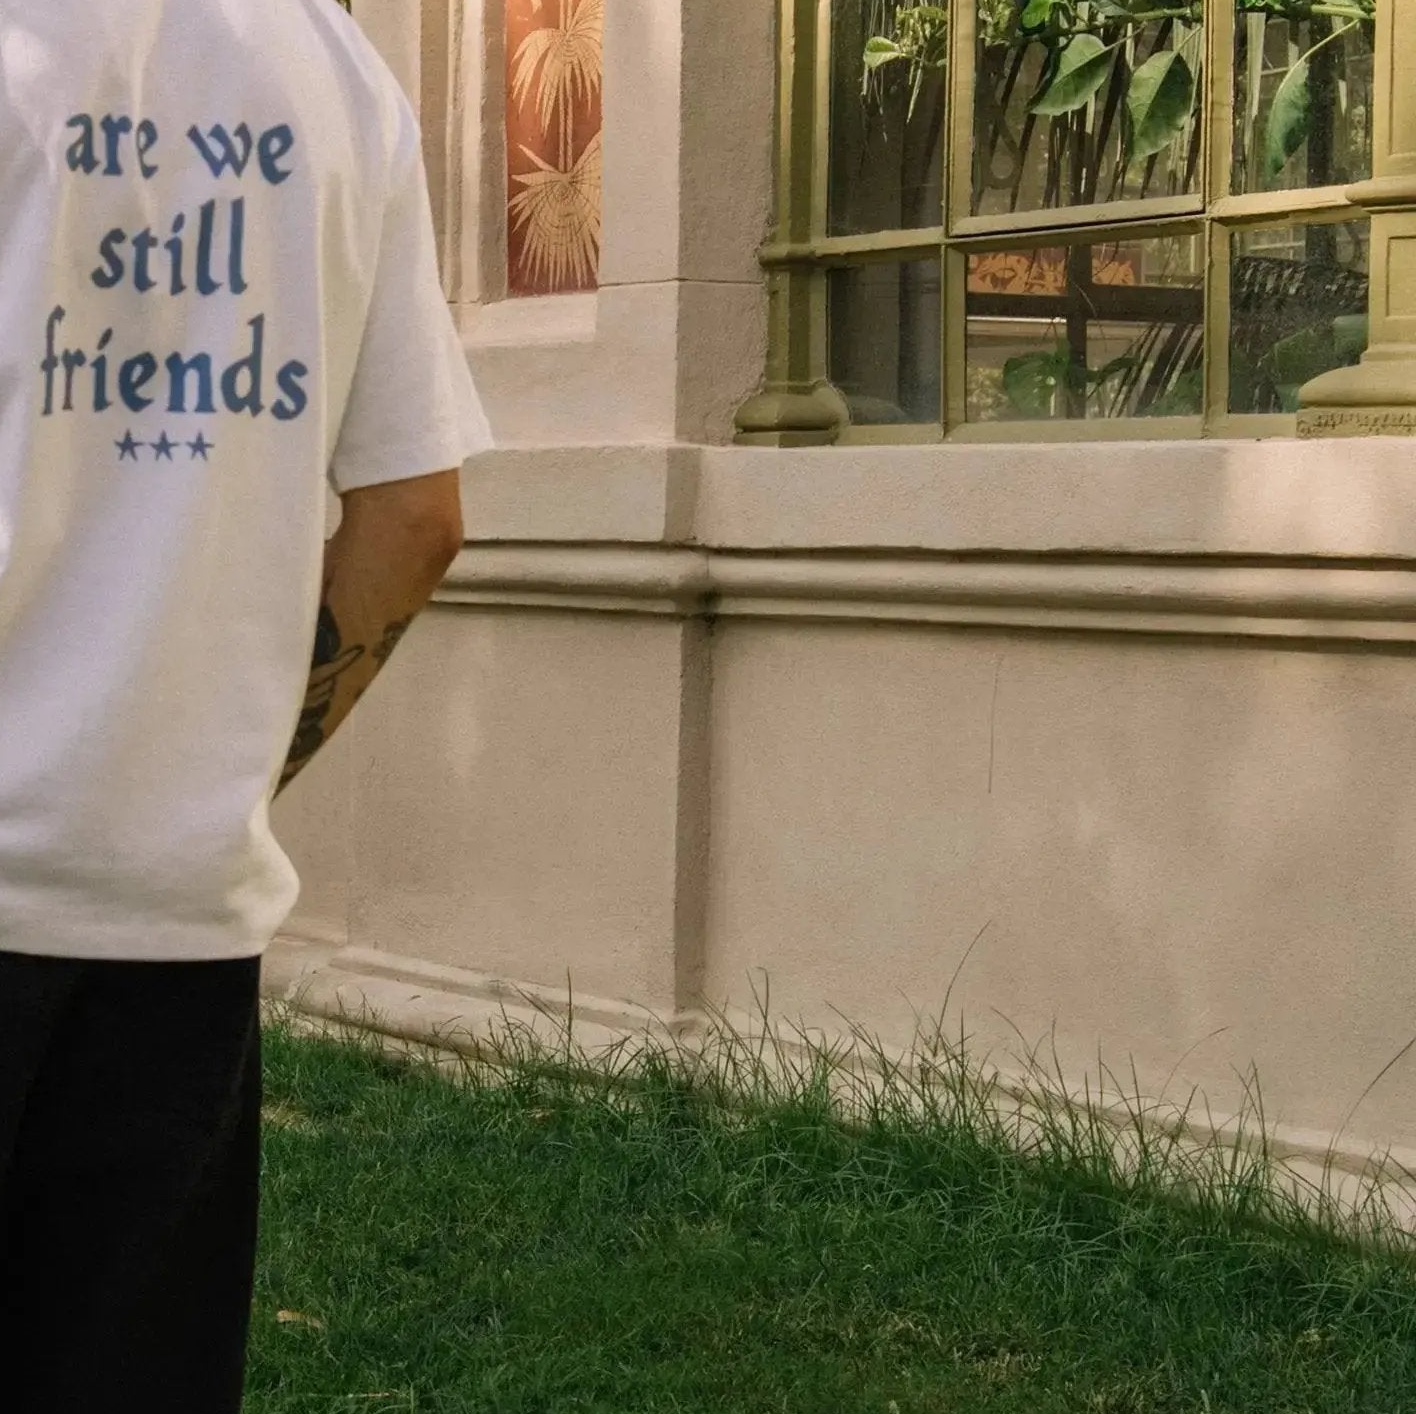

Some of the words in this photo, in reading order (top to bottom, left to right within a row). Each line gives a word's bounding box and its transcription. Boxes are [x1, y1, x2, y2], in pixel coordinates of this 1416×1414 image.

[65, 113, 158, 179] are
[187, 122, 295, 185] we
[91, 196, 248, 296] still
[41, 305, 309, 421] friends
